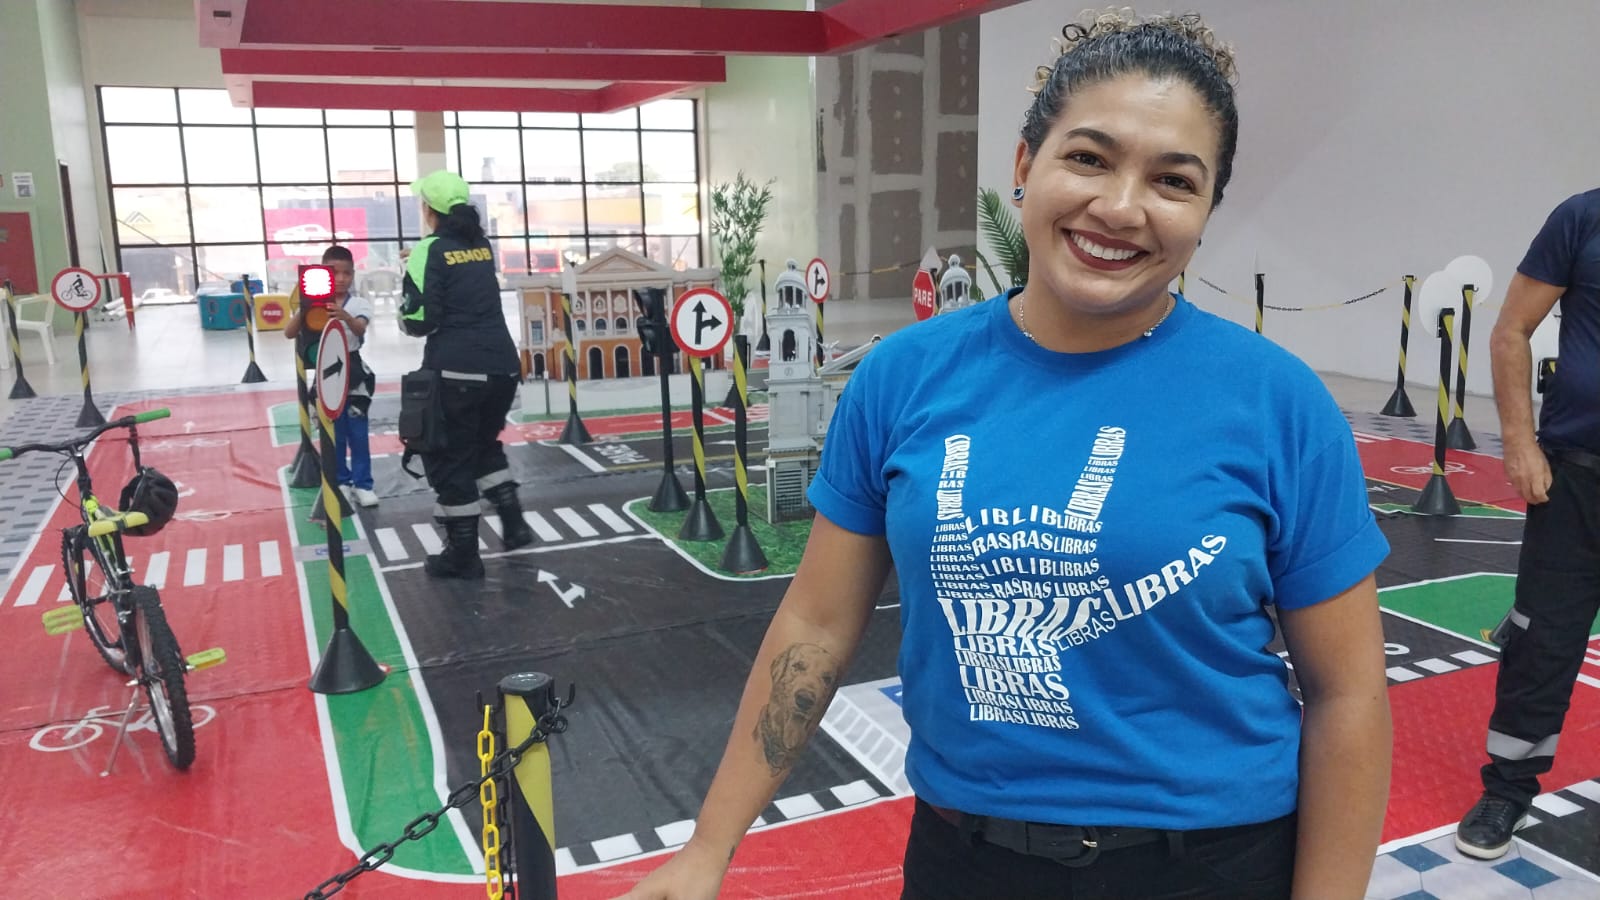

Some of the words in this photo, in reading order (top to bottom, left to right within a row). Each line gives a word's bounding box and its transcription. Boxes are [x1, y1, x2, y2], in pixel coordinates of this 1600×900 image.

[443, 247, 492, 265] SEMOB
[914, 287, 933, 308] PARE
[940, 470, 967, 478] LIB
[1083, 465, 1116, 474] LIBRAS
[938, 480, 965, 488] RAS
[1080, 472, 1114, 482] LIBRAS
[935, 522, 966, 532] LIBRAS
[1056, 513, 1103, 533] LIBRAS
[933, 532, 968, 543] LIBRAS
[931, 543, 972, 553] LIBRAS
[1053, 536, 1098, 554] LIBRAS
[930, 553, 975, 562] LIBRAS
[930, 564, 980, 572] LIBRAS
[1052, 558, 1100, 577] LIBRAS
[1103, 534, 1227, 621] LIBRAS
[934, 581, 990, 590] LIBRAS
[1054, 575, 1110, 597] LIBRAS
[936, 590, 996, 599] LIBRAS
[937, 597, 1101, 641] LIBRAS
[1056, 610, 1117, 651] LIBRAS
[953, 635, 1058, 657] LIBRAS
[959, 665, 1070, 700] LIBRAS
